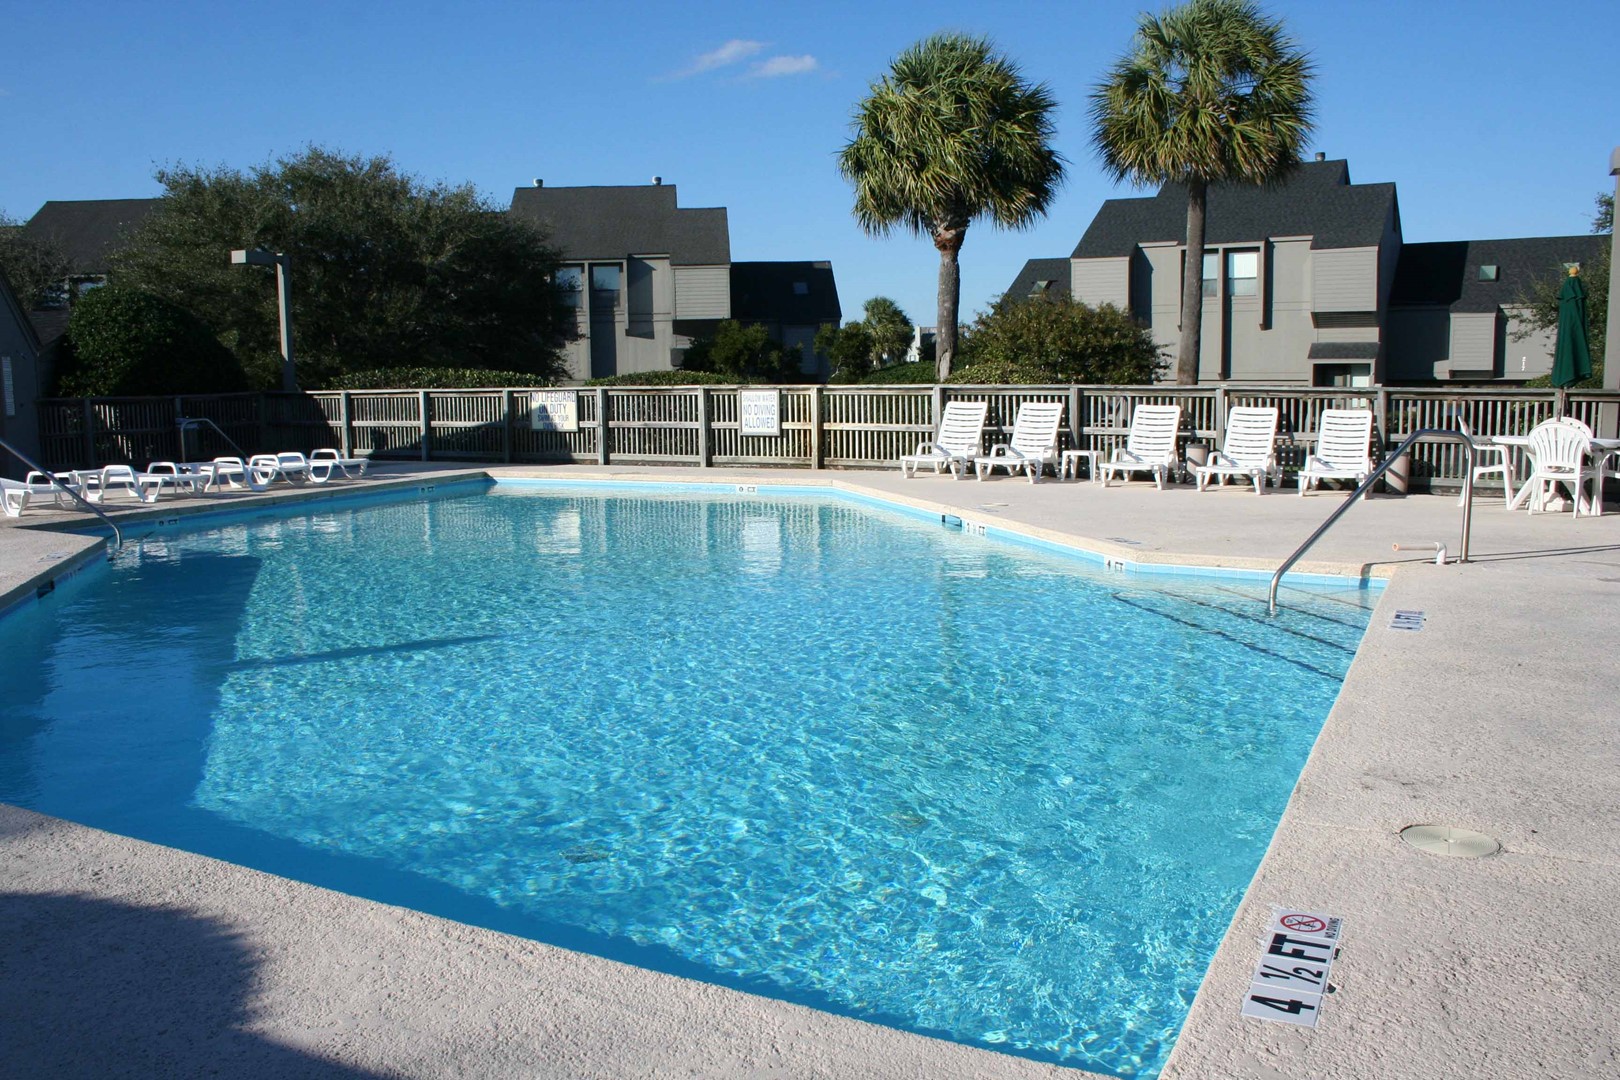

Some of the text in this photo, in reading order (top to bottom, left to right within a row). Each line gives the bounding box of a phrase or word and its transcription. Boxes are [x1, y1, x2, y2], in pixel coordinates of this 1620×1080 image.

[531, 391, 576, 403] NO LIFEGUARD
[538, 403, 567, 414] ON DUTY
[743, 404, 776, 416] NO DIVING
[744, 417, 775, 429] ALLOWED
[1267, 932, 1331, 963] FT
[1250, 994, 1316, 1015] 4
